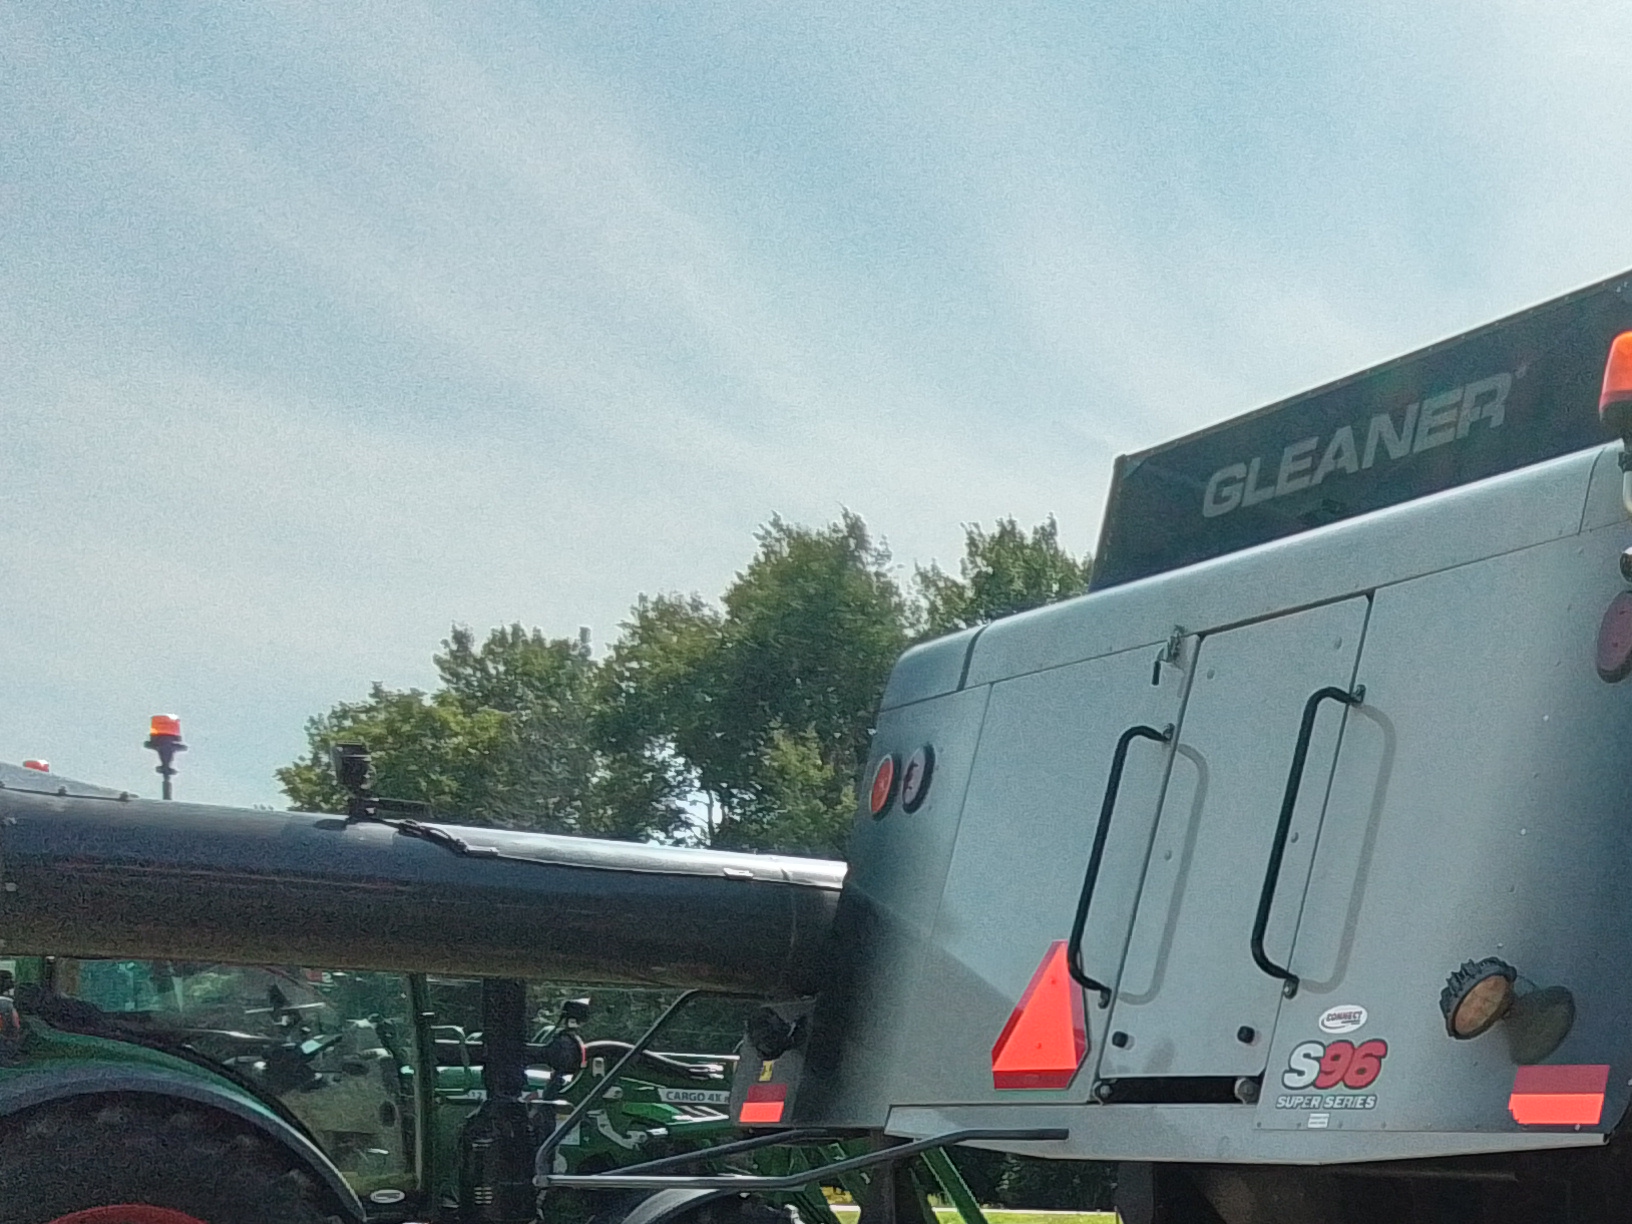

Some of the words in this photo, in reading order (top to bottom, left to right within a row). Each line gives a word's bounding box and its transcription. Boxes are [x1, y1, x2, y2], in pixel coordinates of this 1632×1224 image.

[1203, 373, 1512, 518] GLEANER
[1282, 1038, 1388, 1090] S96
[666, 1091, 705, 1102] CARGO
[1276, 1095, 1321, 1109] SUPER
[1323, 1095, 1377, 1109] SERIES
